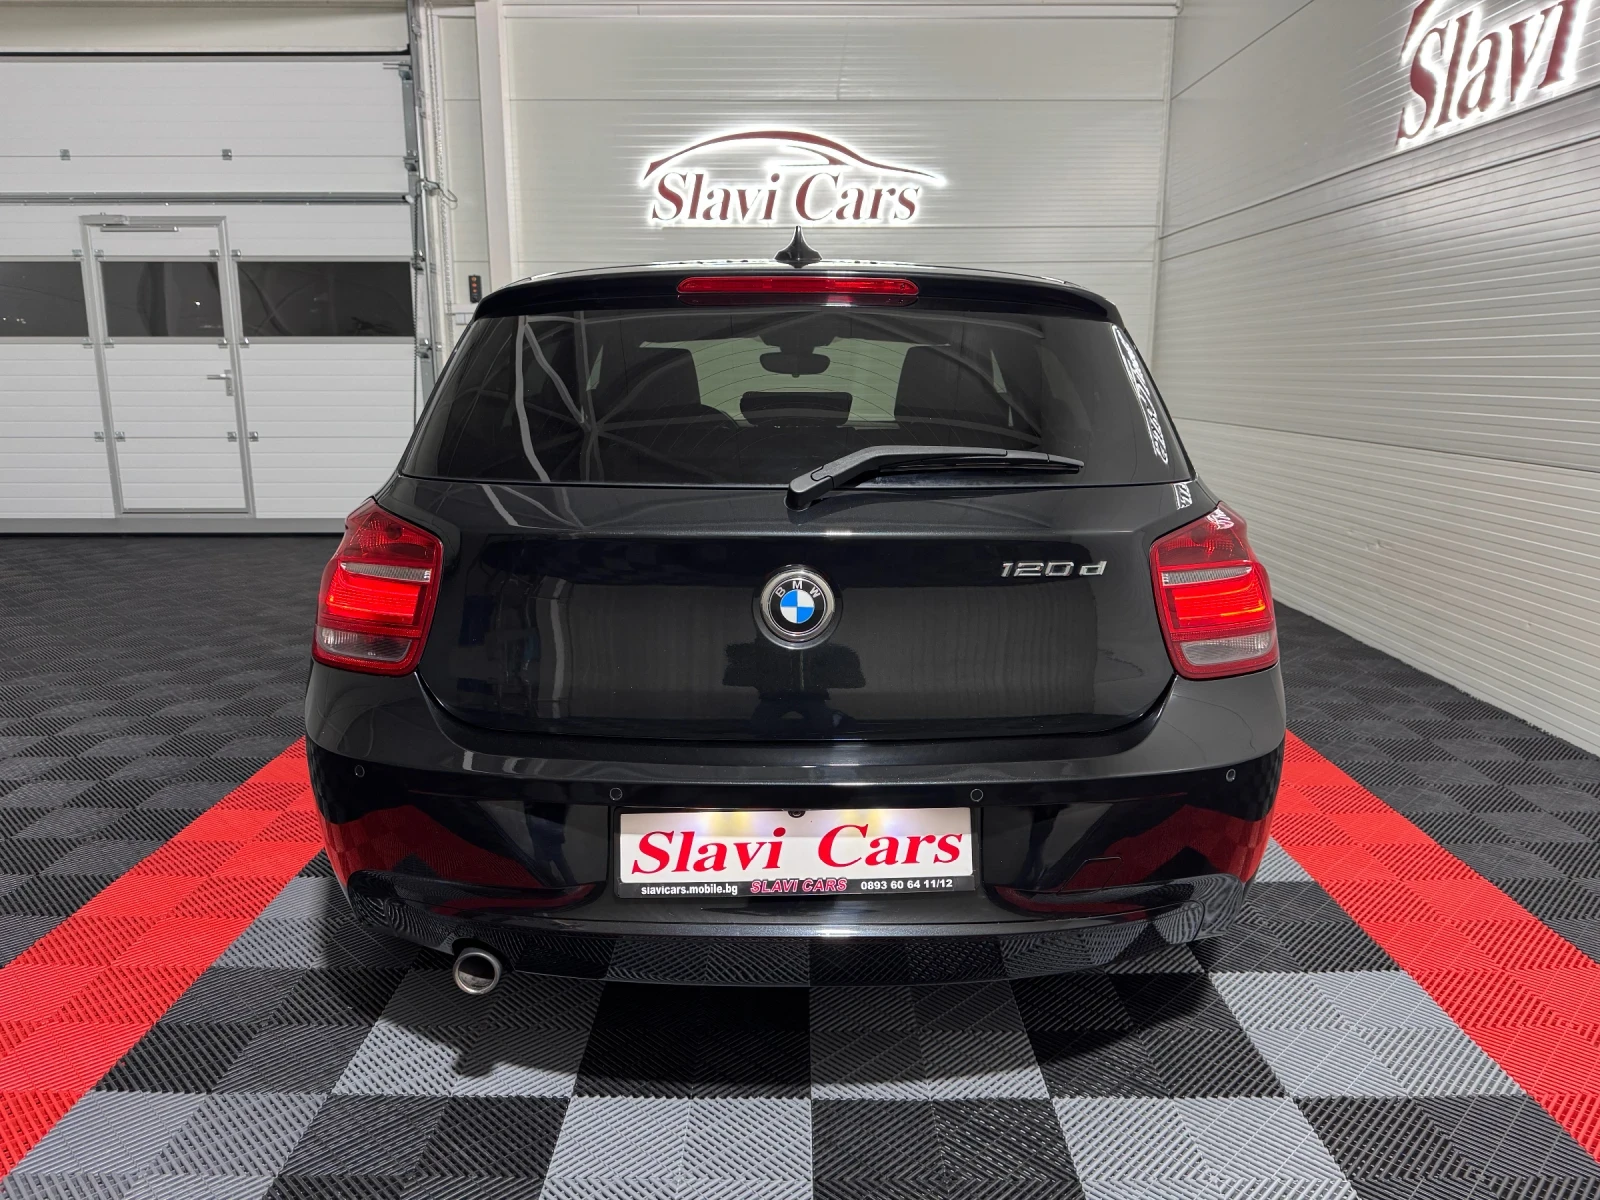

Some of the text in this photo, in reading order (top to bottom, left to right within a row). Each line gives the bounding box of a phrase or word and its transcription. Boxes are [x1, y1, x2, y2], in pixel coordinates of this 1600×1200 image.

[651, 172, 921, 221] Slavi Cars
[775, 580, 821, 599] BMW
[631, 824, 963, 875] Slavi Cars
[641, 883, 738, 896] slavicars.mobile.bg
[750, 877, 848, 894] SLAVI CARS
[860, 878, 954, 891] 0893 60 64 11/12
